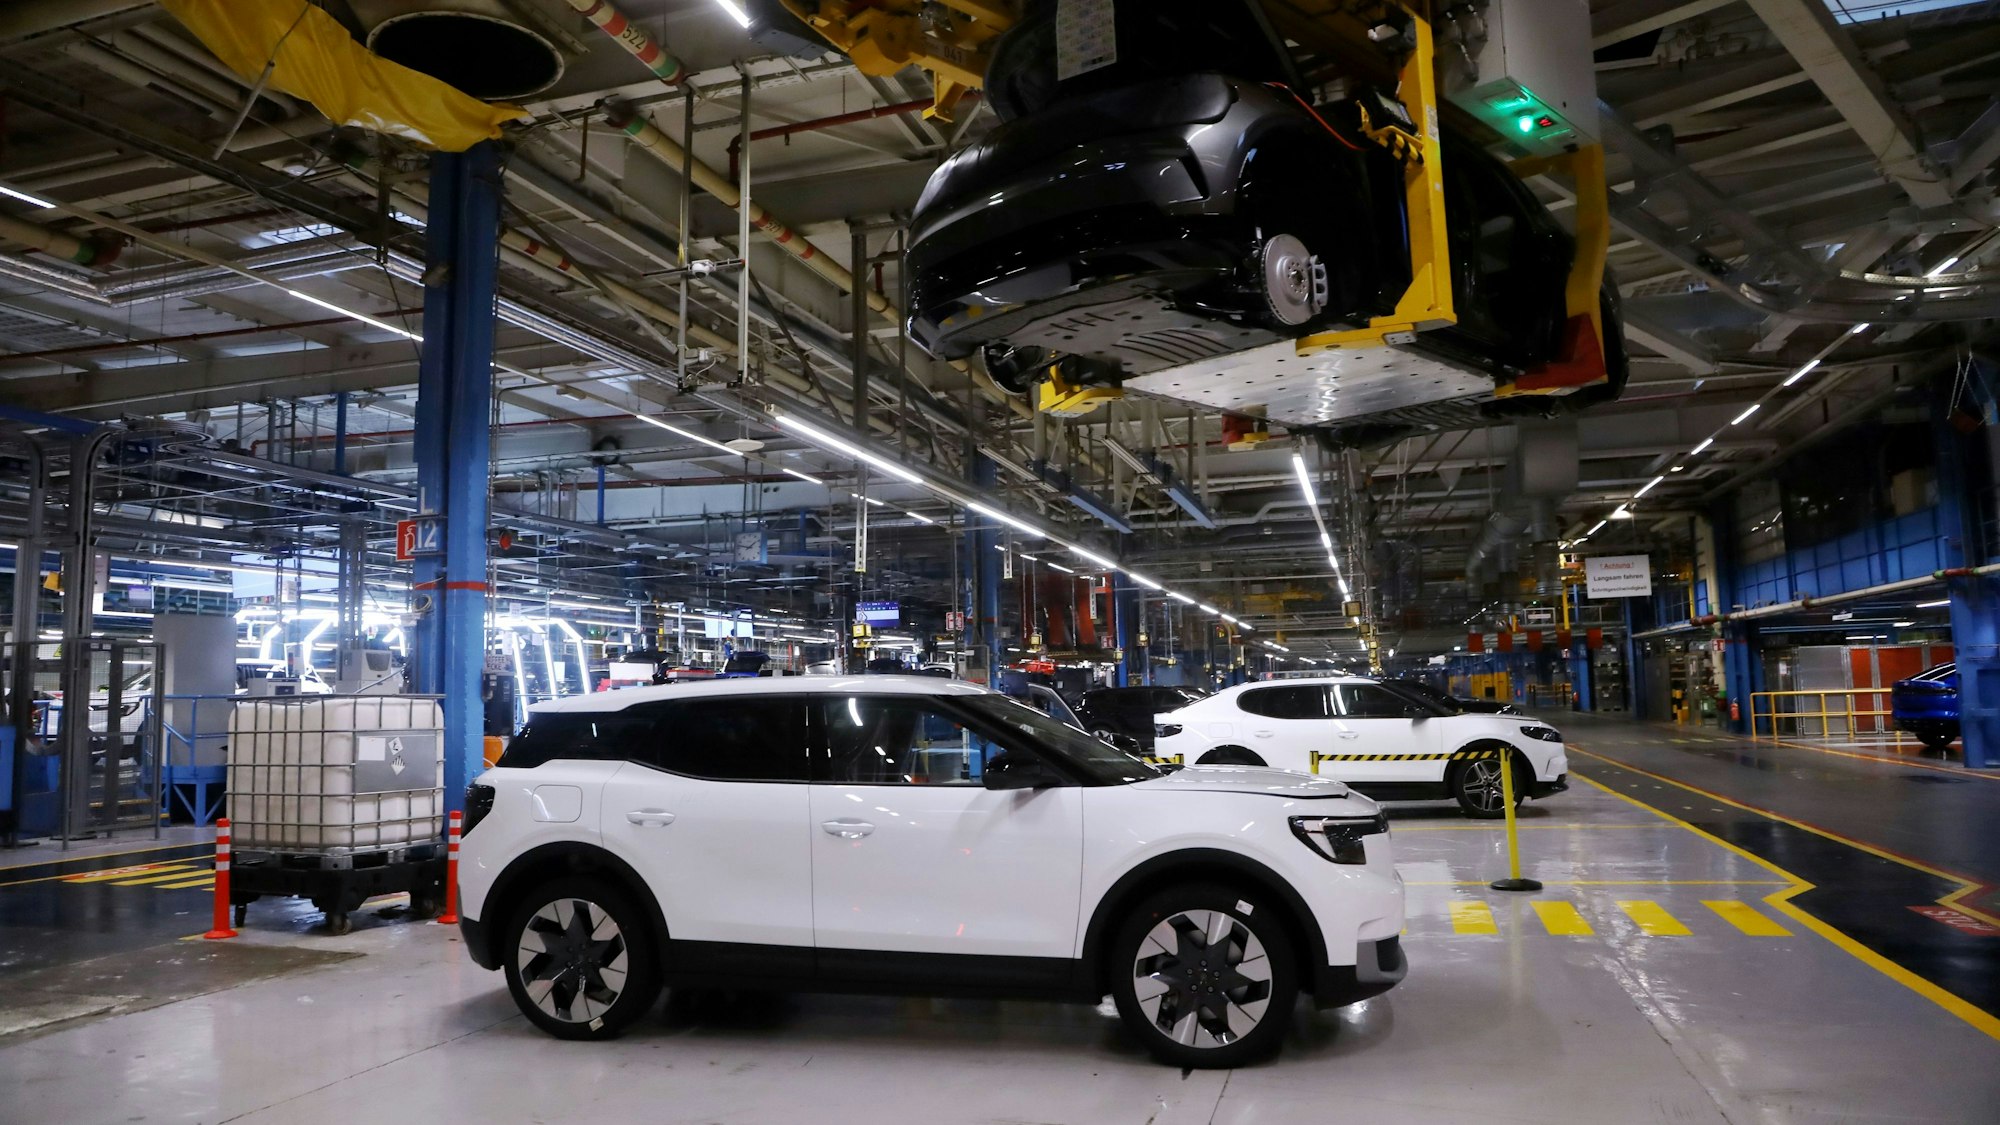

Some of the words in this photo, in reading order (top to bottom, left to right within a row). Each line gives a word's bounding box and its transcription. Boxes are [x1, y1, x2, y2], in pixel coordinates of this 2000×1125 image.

[622, 26, 646, 50] 522
[420, 486, 434, 514] L
[417, 520, 437, 549] 12
